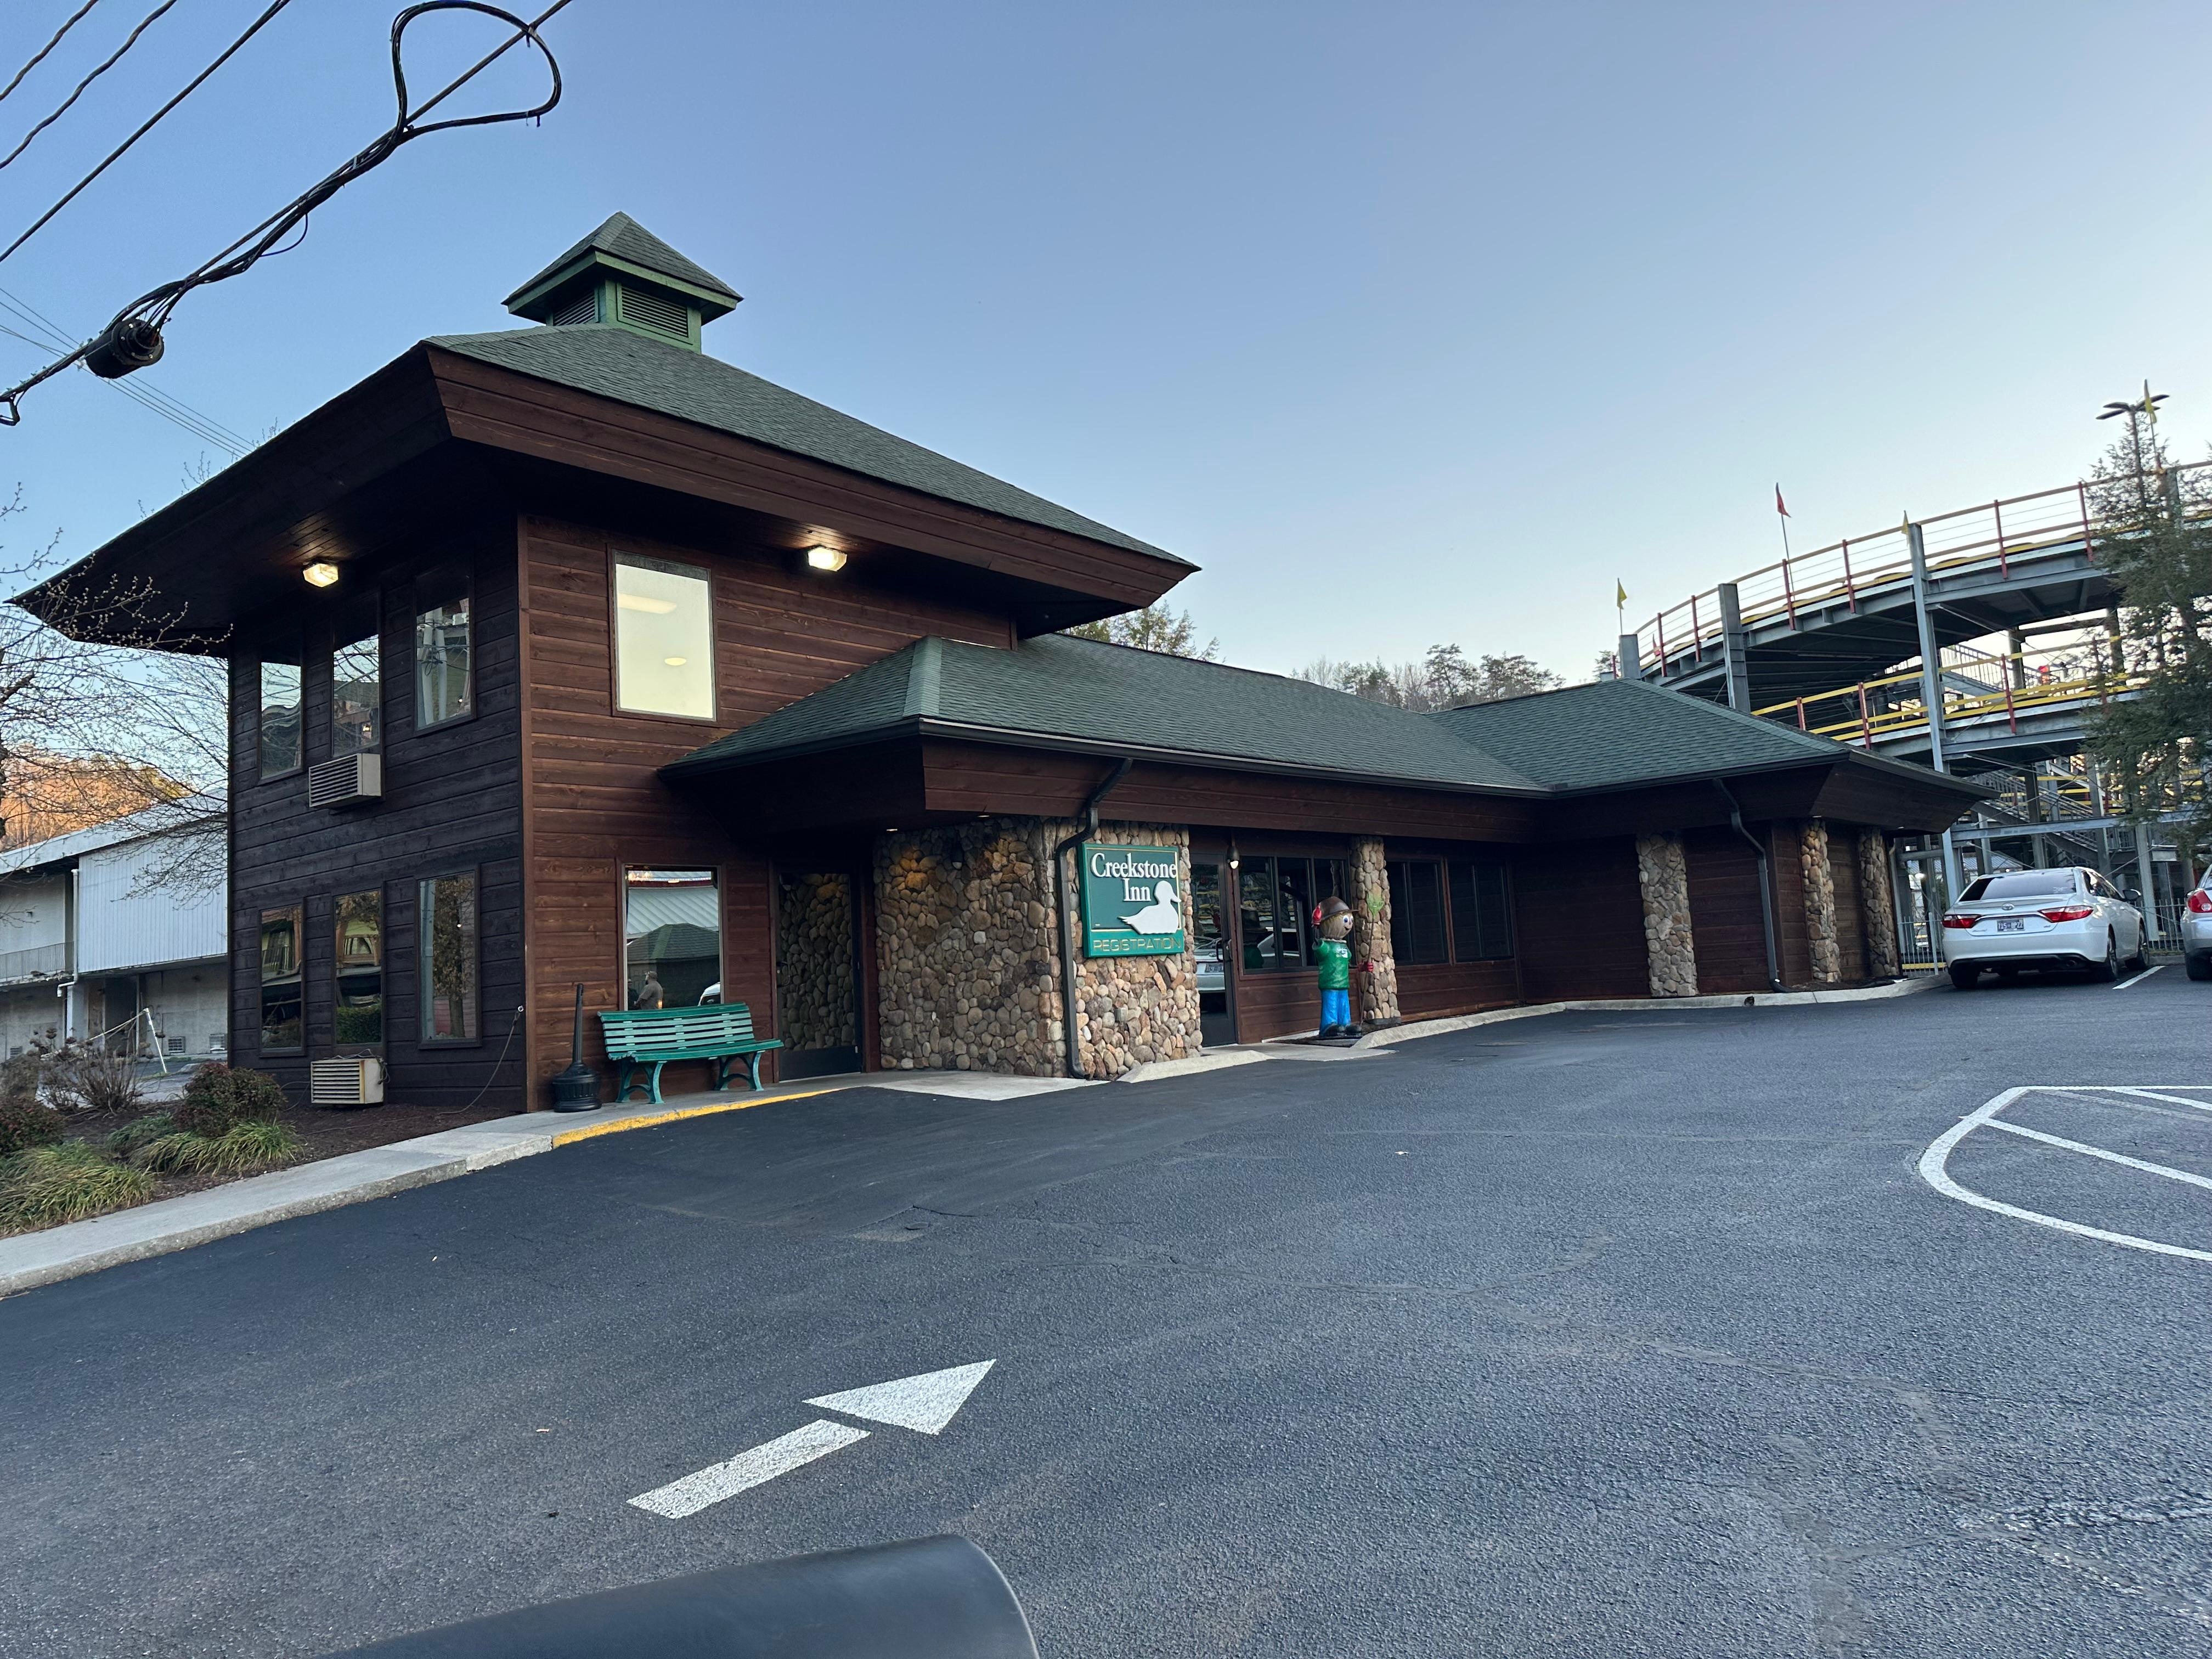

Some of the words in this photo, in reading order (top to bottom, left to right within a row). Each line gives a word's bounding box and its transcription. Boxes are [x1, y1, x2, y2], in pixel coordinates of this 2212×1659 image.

[1091, 853, 1177, 878] Creekstone
[1122, 878, 1152, 901] Inn
[1093, 938, 1181, 951] REGISTRATION
